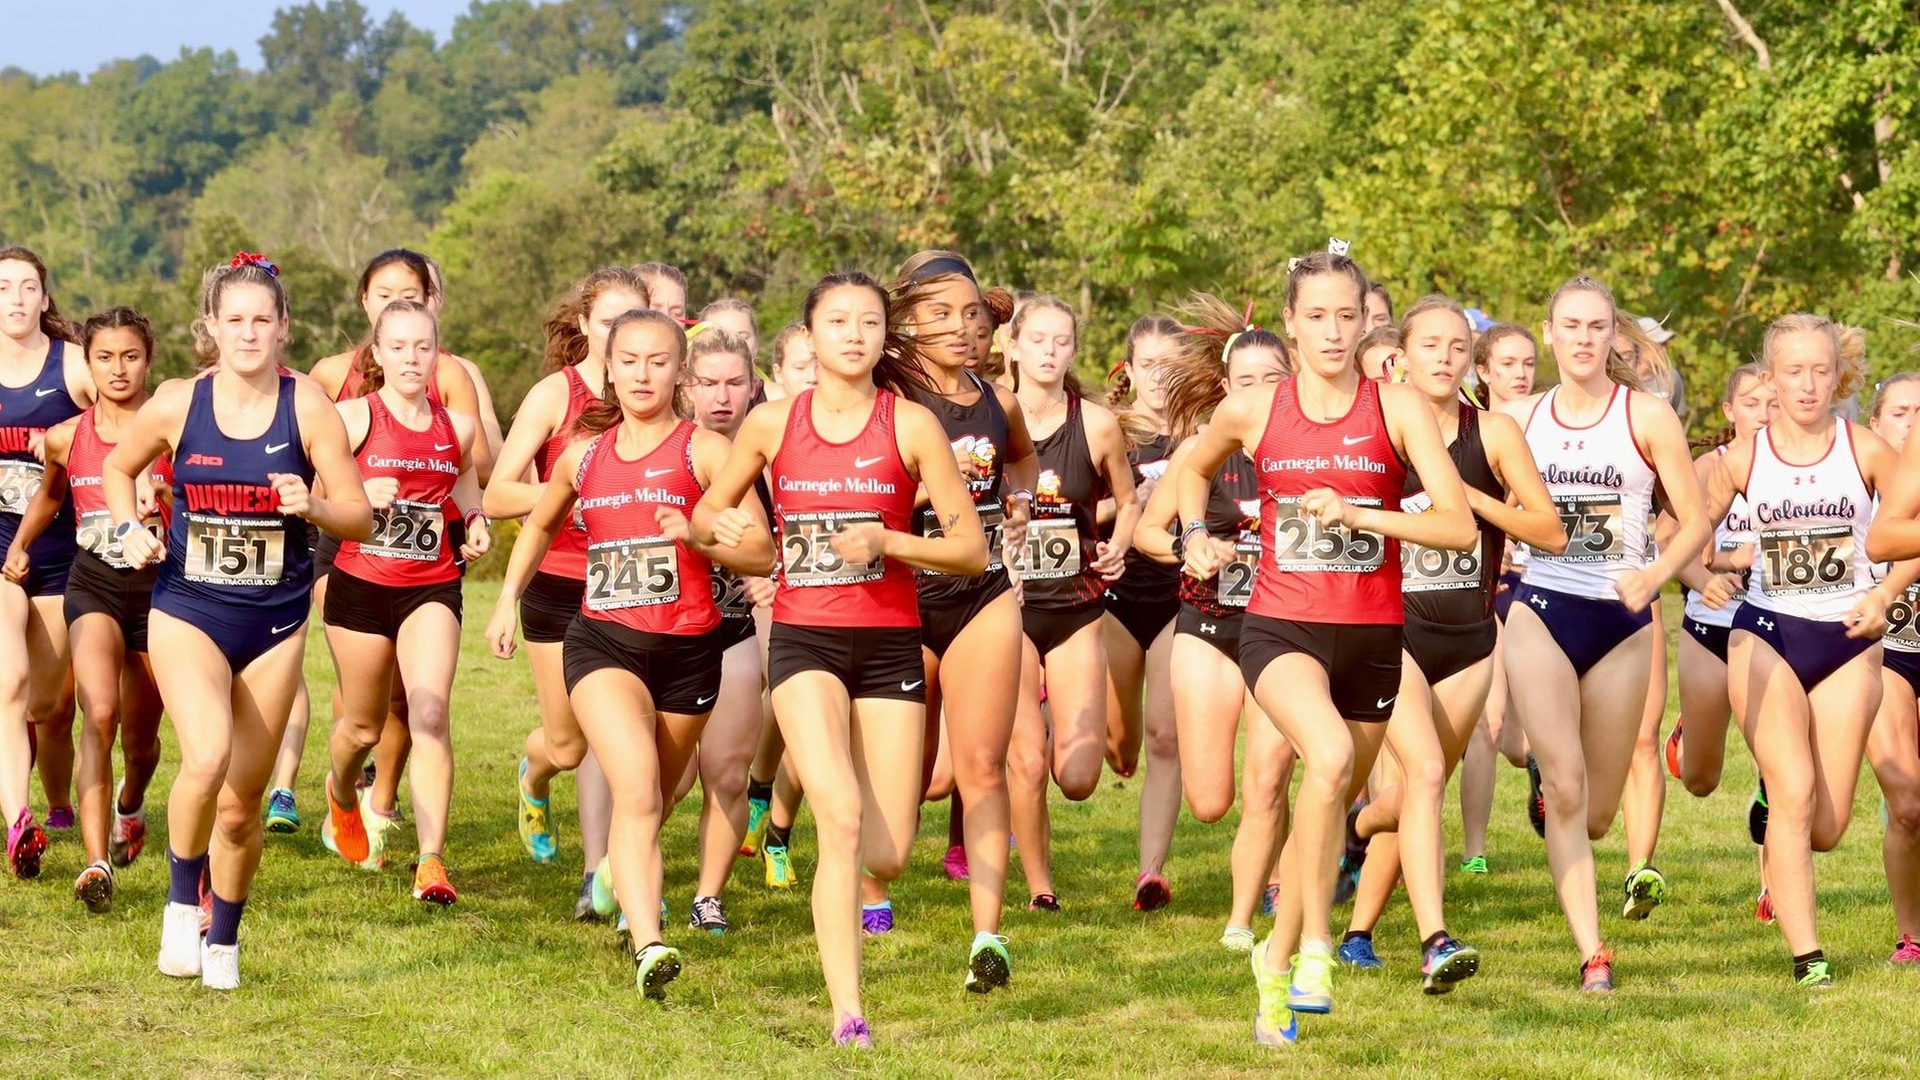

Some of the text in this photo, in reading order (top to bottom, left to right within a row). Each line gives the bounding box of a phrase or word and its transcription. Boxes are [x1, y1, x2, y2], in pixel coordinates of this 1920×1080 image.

[367, 455, 426, 471] Carnegie
[1261, 454, 1386, 474] Carnegie Mellon
[634, 487, 686, 506] Mellon
[778, 475, 896, 497] Carnegie Mellon
[1757, 496, 1855, 524] Colonials
[372, 512, 438, 553] 226
[1279, 517, 1381, 563] 255
[199, 534, 268, 577] 151
[1765, 546, 1848, 588] 186
[588, 555, 675, 601] 245
